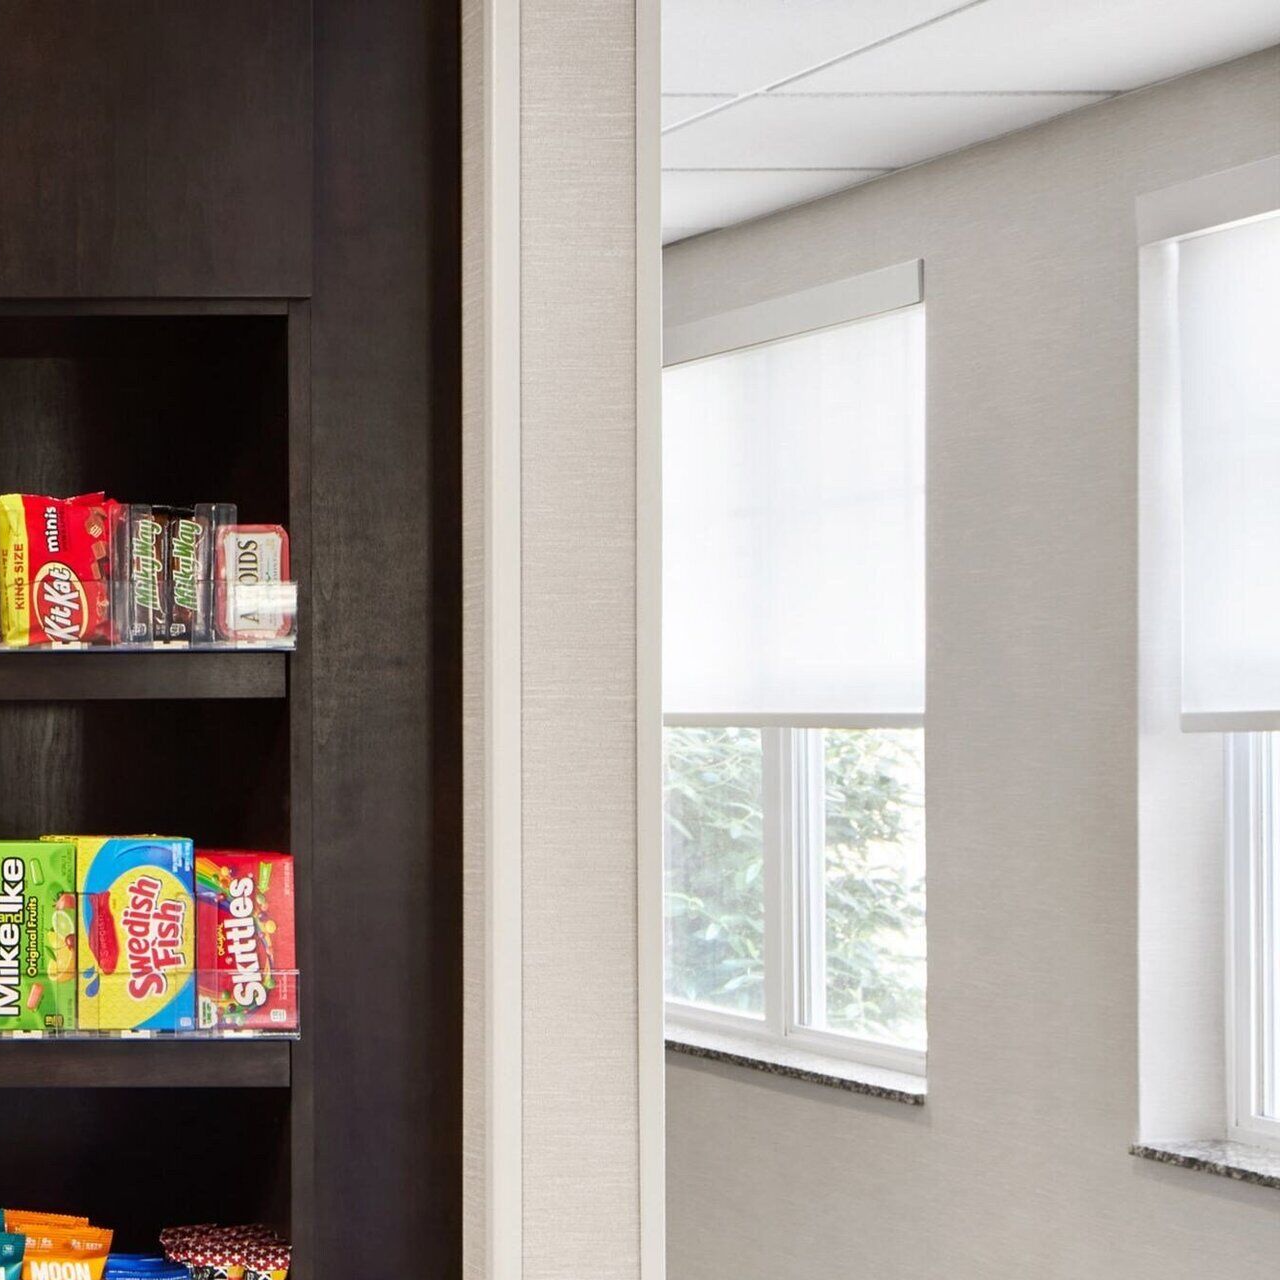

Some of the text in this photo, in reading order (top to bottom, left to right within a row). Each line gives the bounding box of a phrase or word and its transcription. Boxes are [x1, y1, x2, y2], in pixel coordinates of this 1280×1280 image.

[46, 506, 57, 553] minis
[14, 543, 25, 610] KING SIZE
[238, 540, 259, 624] AOIDS
[27, 897, 37, 977] Original Fruits
[122, 876, 167, 1000] Swedish
[152, 900, 183, 968] Fish
[224, 878, 266, 1006] Skittles
